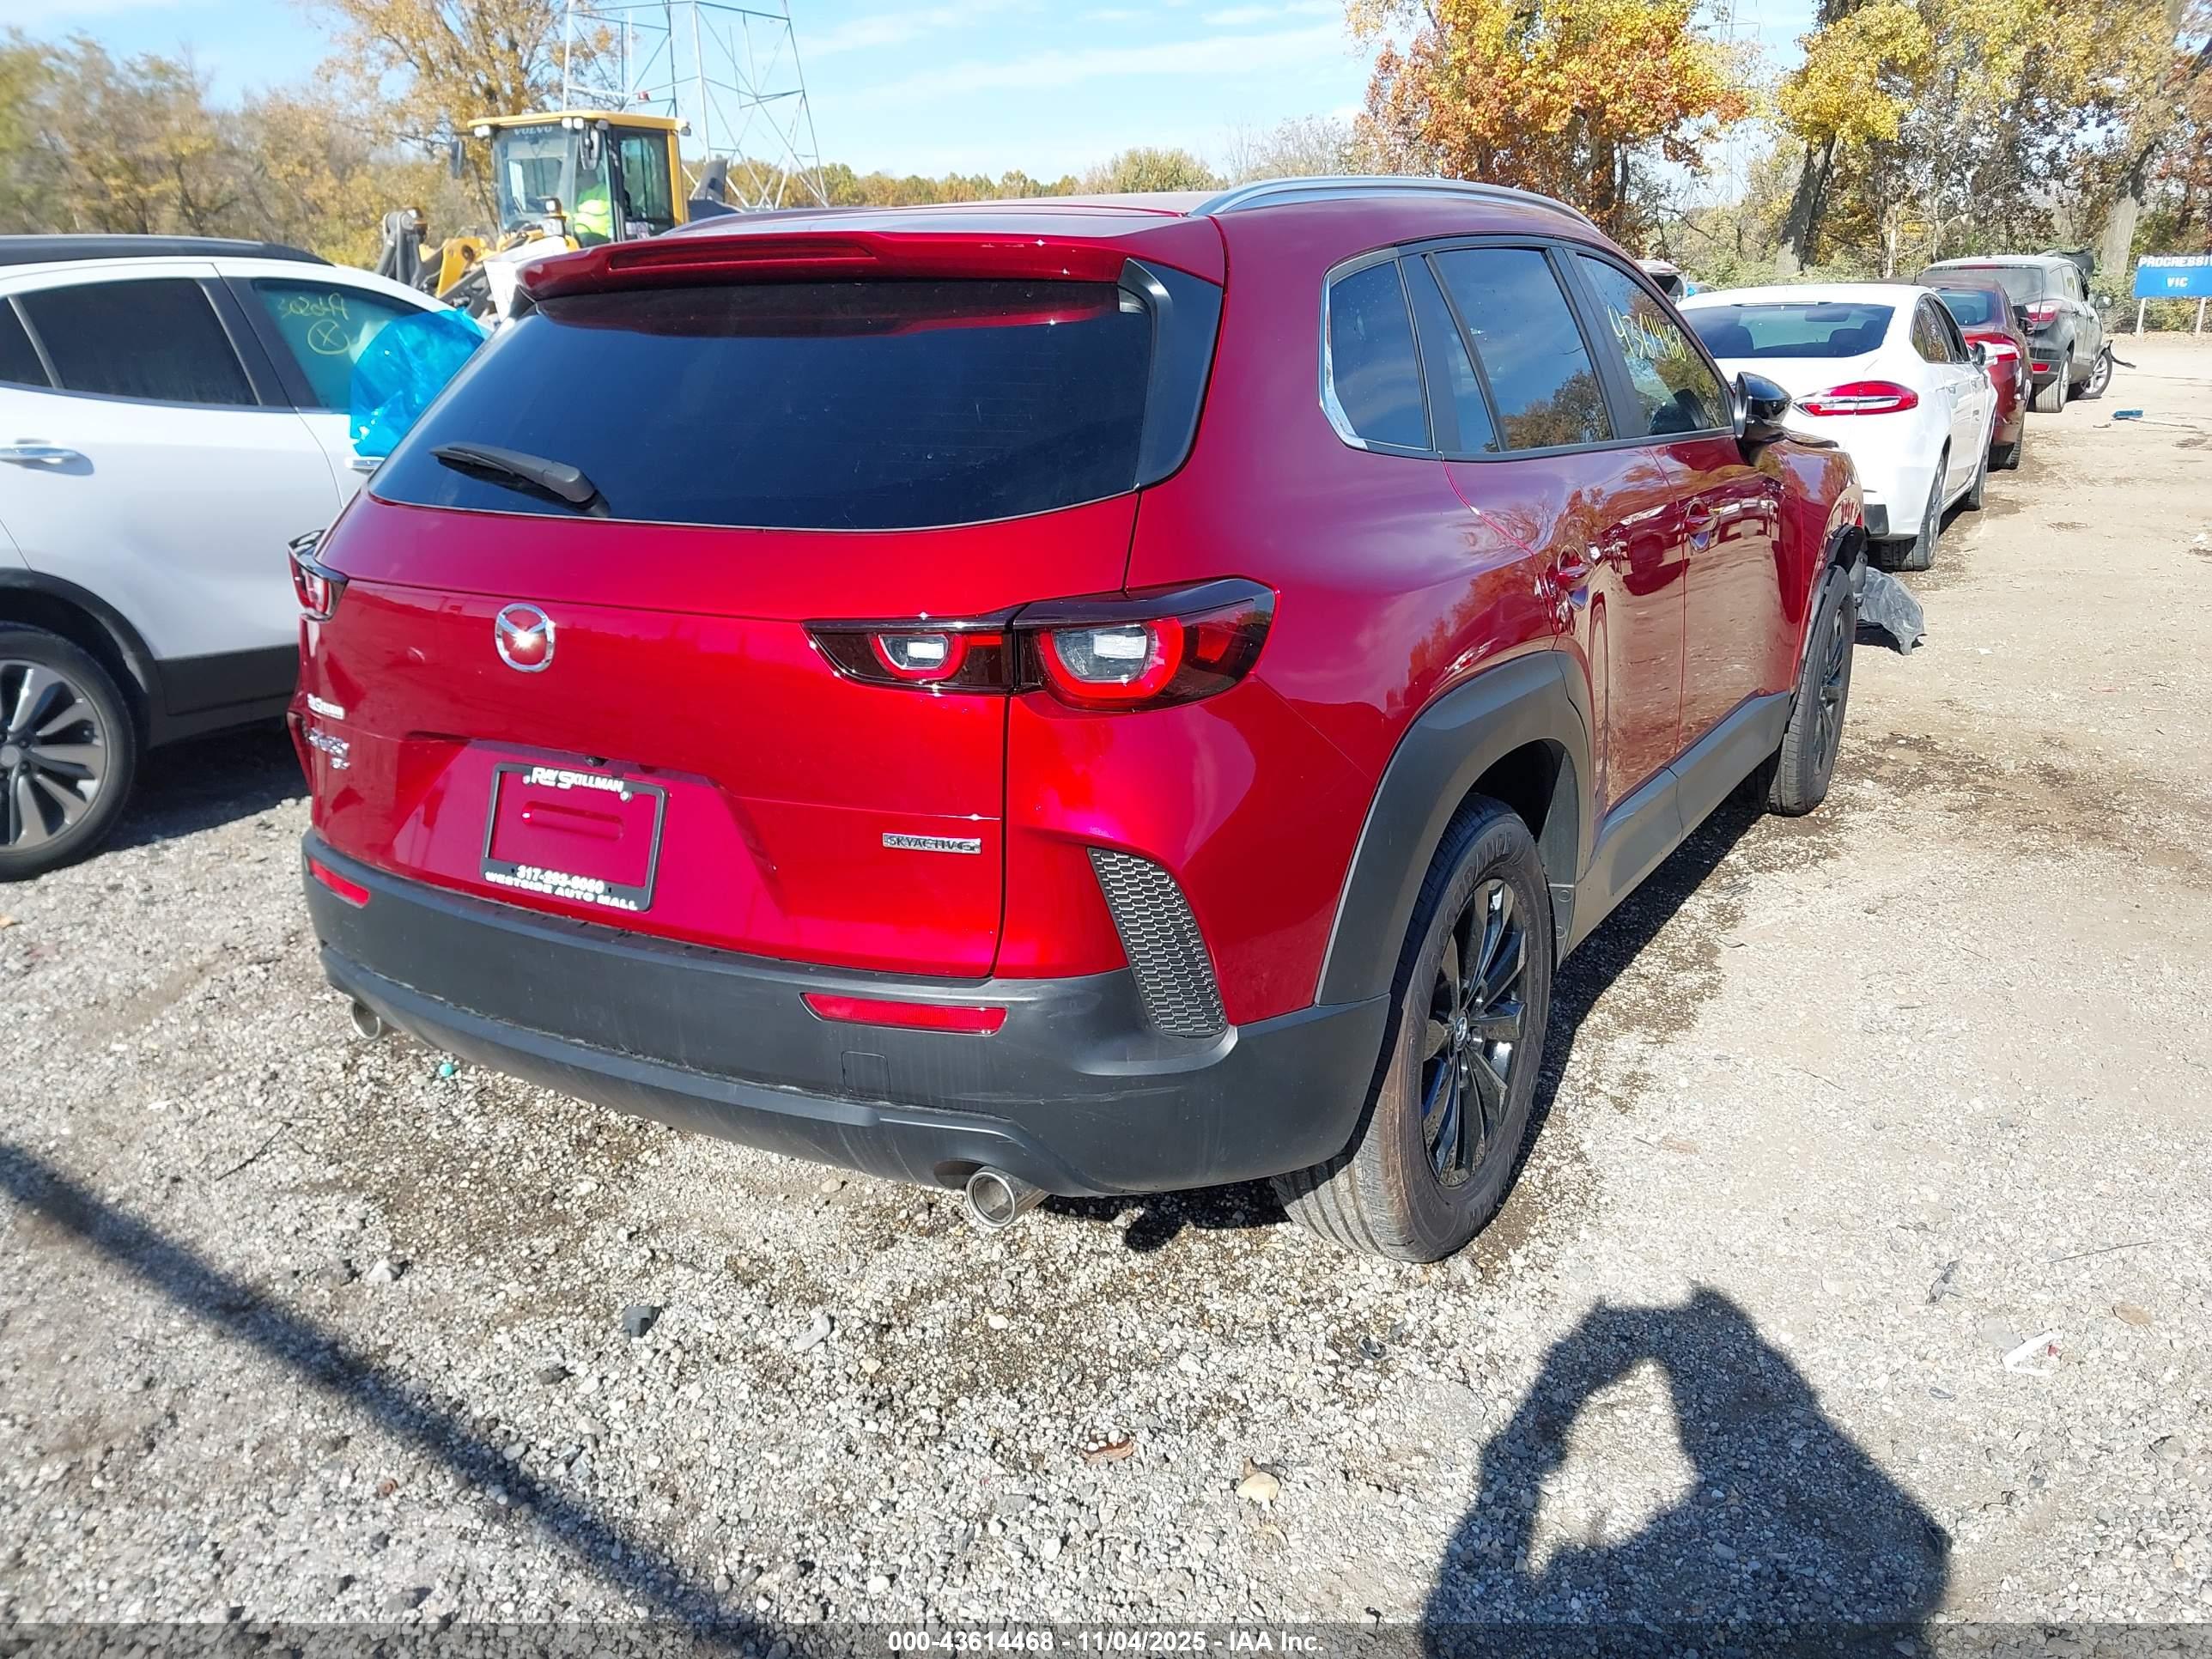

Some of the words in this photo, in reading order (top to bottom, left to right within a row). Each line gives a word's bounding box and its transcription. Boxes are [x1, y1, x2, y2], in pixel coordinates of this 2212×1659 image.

[514, 125, 553, 136] VOLVO
[2138, 255, 2212, 268] PROGRESSI
[2166, 276, 2189, 288] VIC
[554, 887, 594, 902] AUTO
[596, 894, 639, 911] MALL
